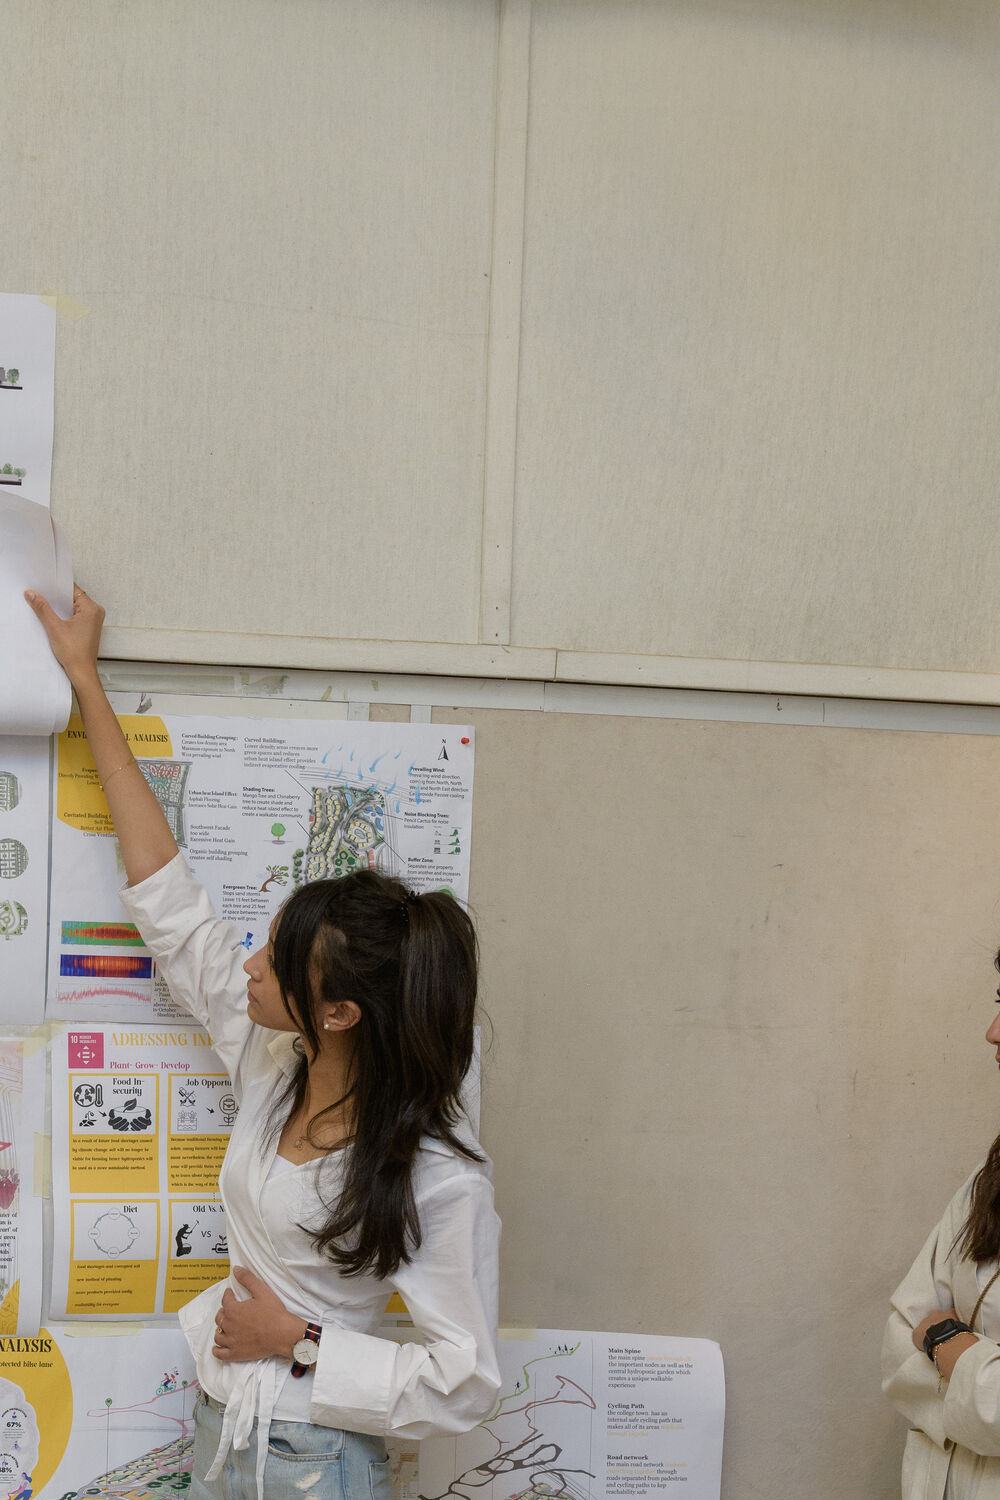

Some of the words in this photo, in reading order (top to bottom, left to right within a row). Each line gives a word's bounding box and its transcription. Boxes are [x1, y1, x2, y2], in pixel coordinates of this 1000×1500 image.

[134, 734, 168, 743] ANALYSIS
[70, 1035, 78, 1044] 10
[109, 1032, 188, 1047] ADRESSING
[160, 1061, 190, 1071] Develop
[112, 1077, 131, 1086] Food
[134, 1077, 144, 1085] In-
[186, 1078, 199, 1086] Job
[112, 1087, 142, 1097] security
[123, 1205, 138, 1213] Diet
[192, 1205, 206, 1213] Old
